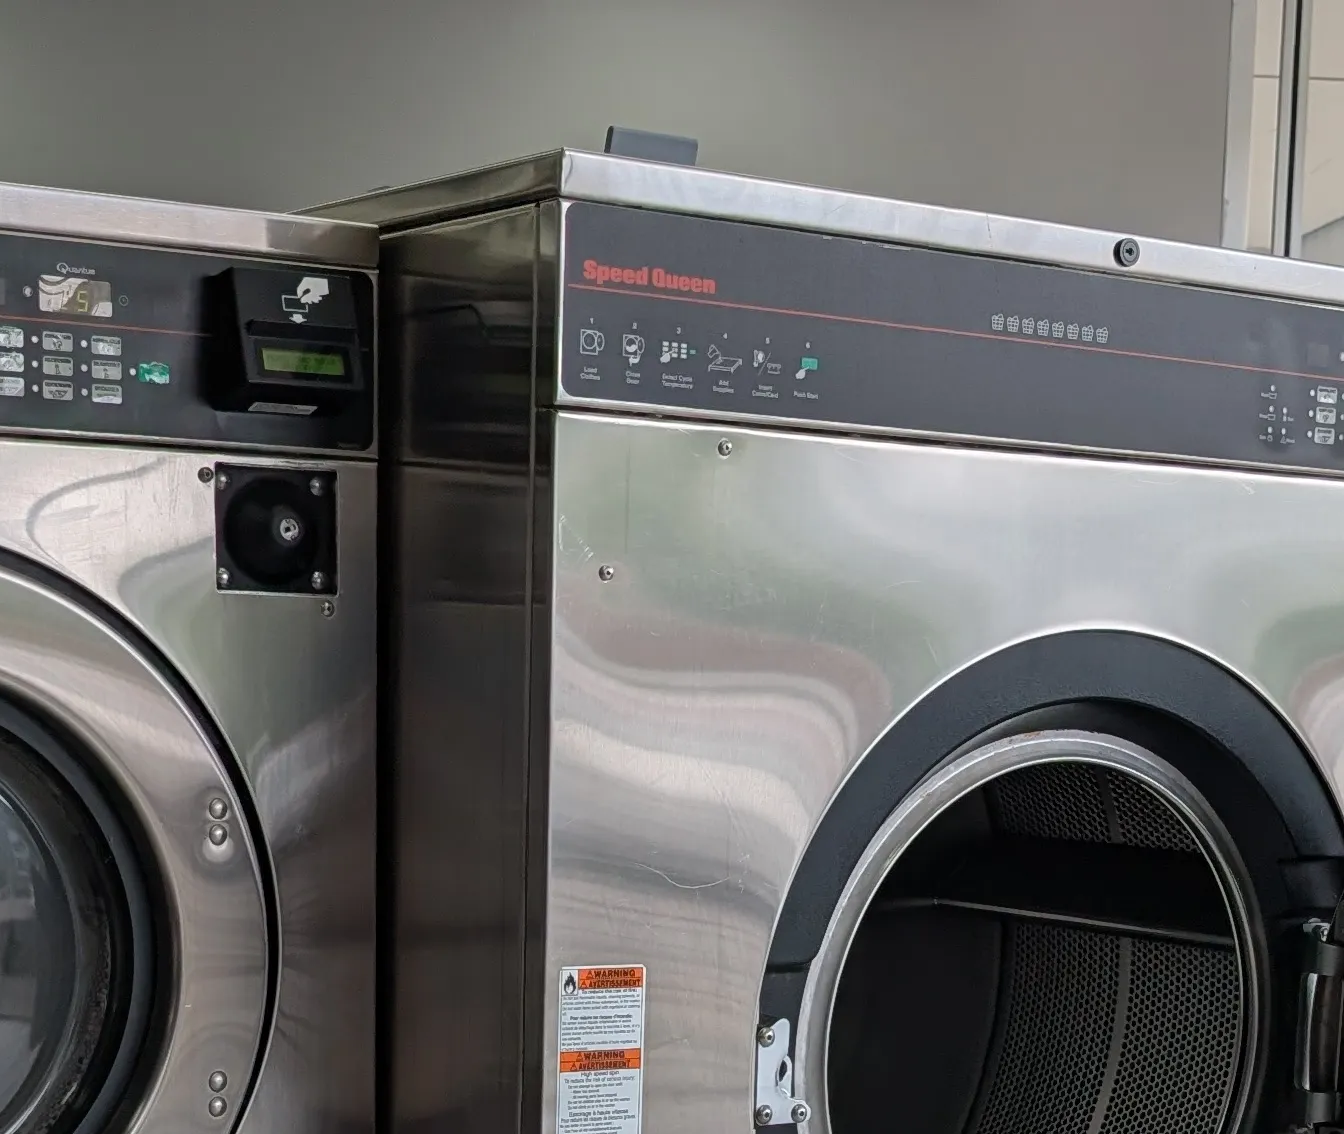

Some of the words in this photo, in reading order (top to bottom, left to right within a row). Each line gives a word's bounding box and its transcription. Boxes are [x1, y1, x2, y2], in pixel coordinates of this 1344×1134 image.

[56, 262, 95, 275] Quantum
[583, 259, 648, 285] Speed
[652, 268, 716, 294] Queen
[594, 969, 636, 978] WARNING
[588, 979, 641, 988] AVERTISSEMENT
[584, 1051, 625, 1060] WARNING
[579, 1059, 631, 1070] AVERTISSEMENT
